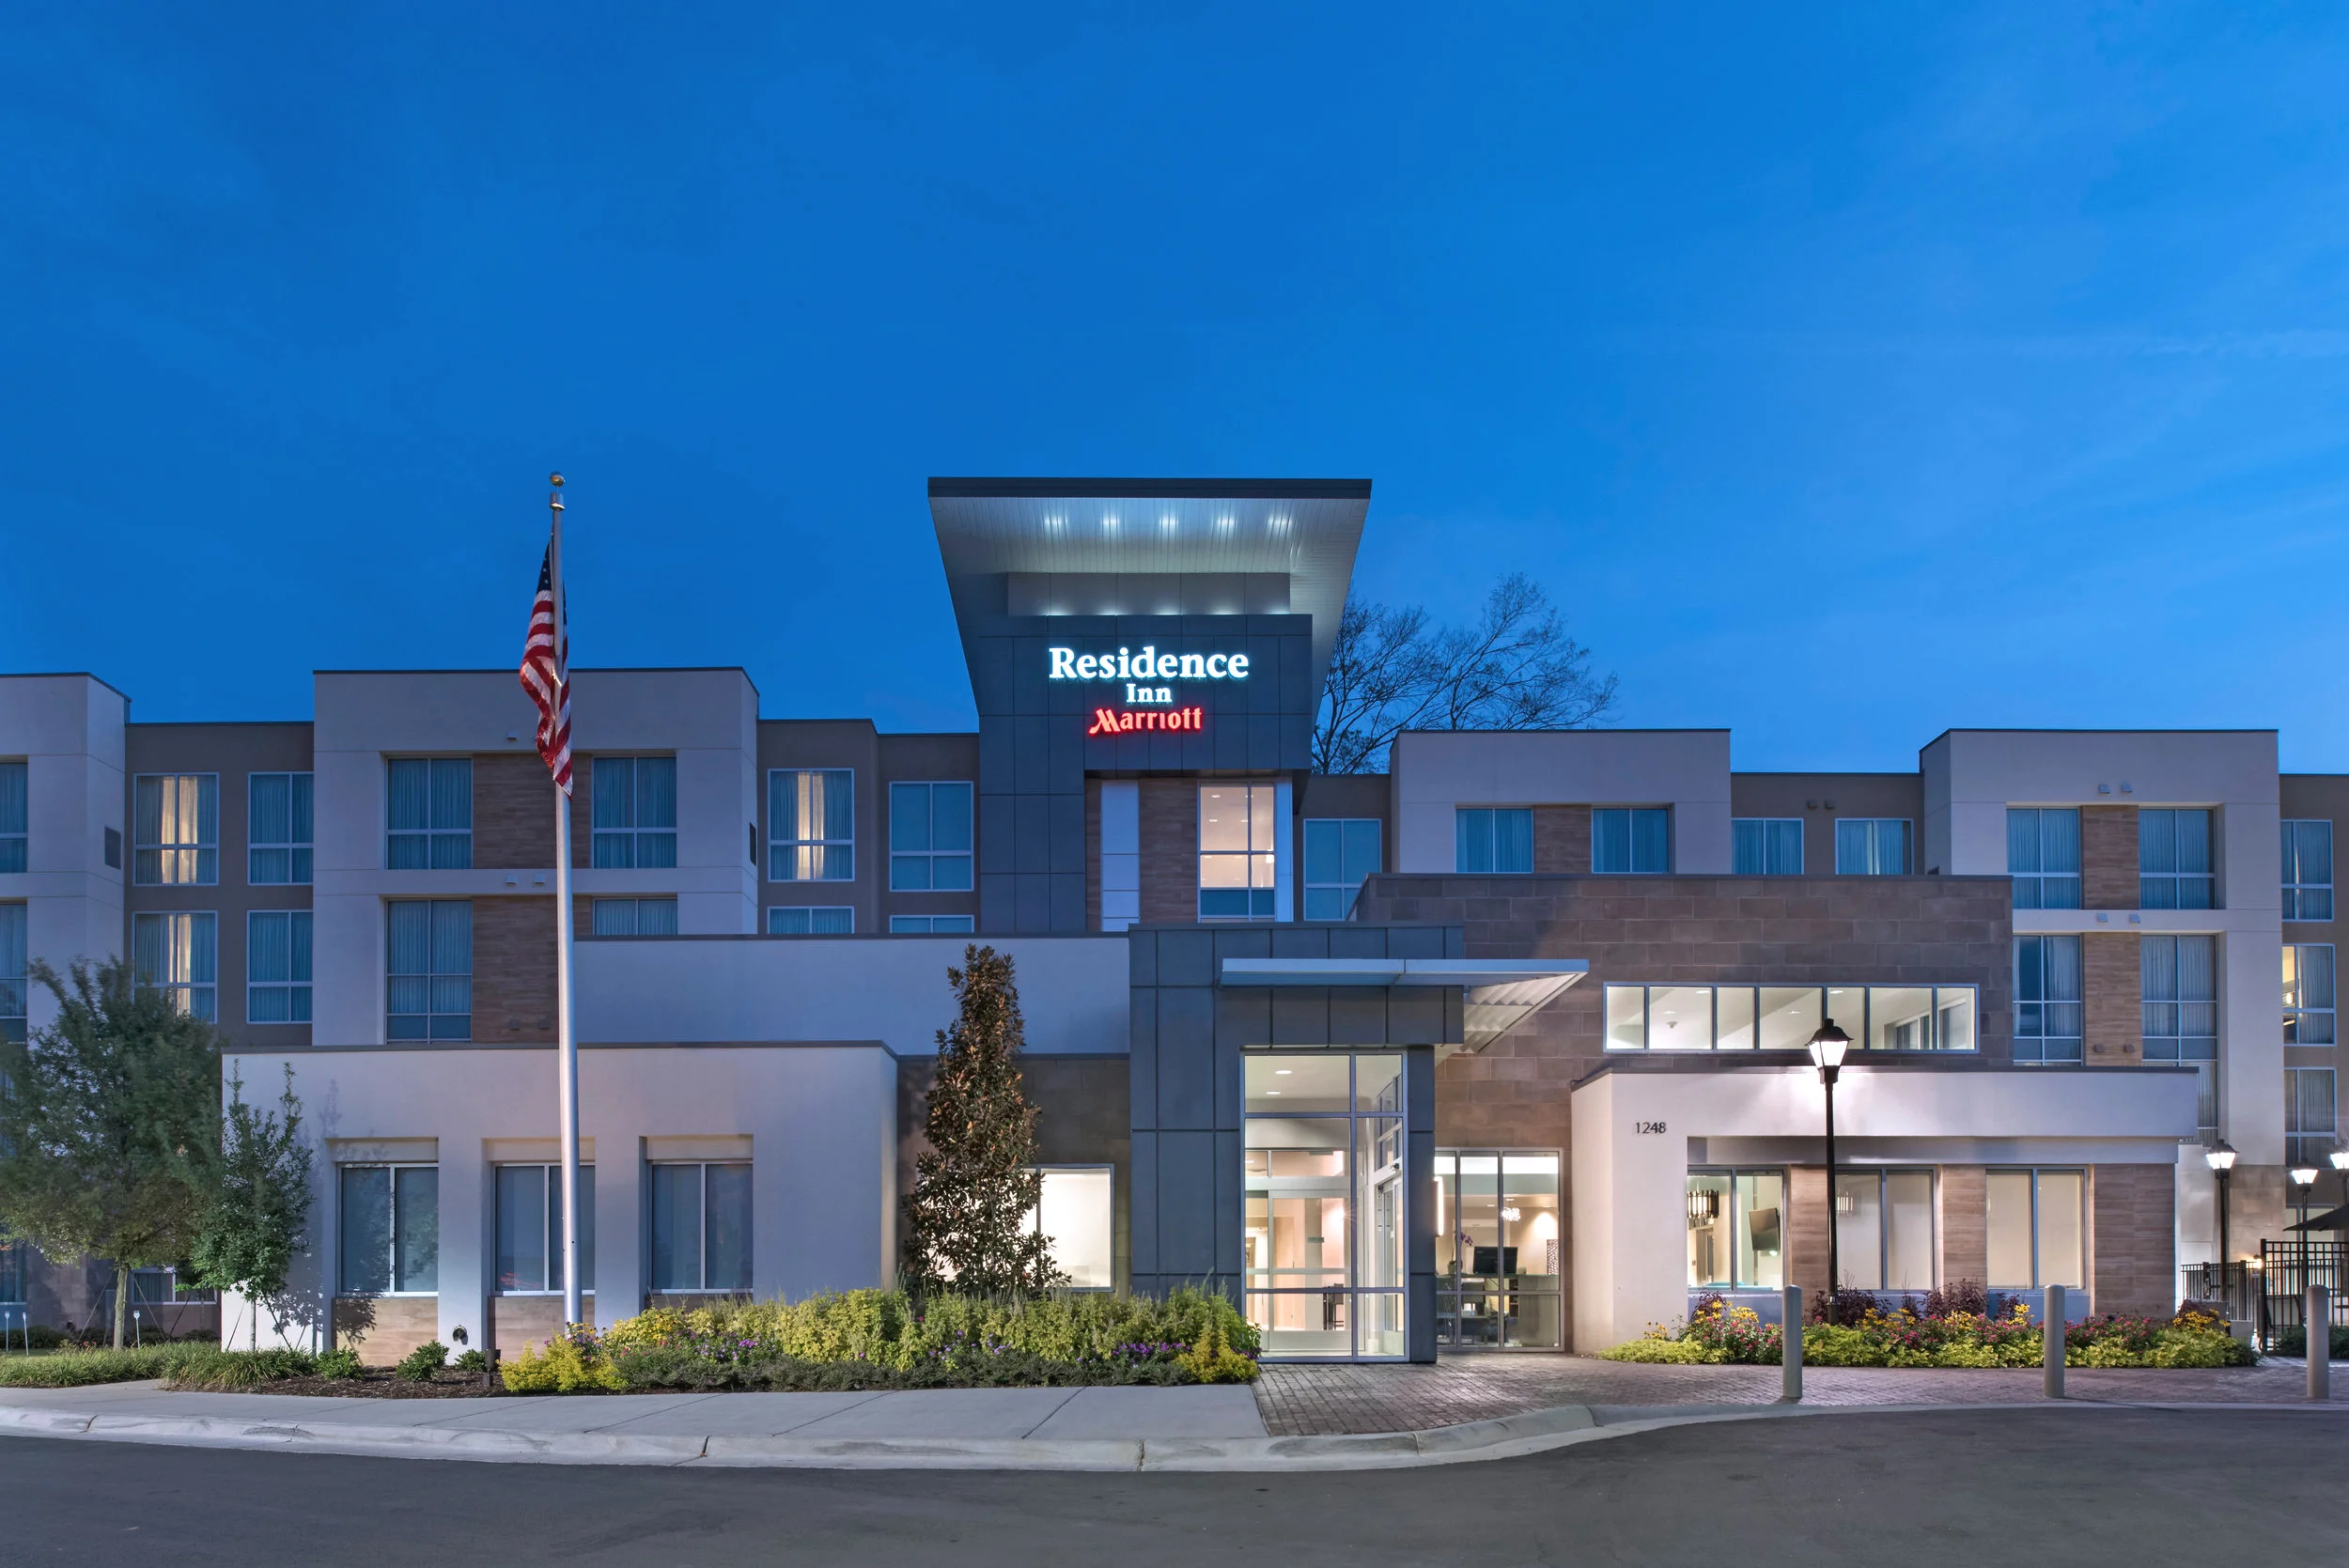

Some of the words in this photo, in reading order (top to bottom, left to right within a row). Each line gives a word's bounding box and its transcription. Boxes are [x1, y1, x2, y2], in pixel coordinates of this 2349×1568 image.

[1049, 646, 1250, 678] Residence
[1126, 683, 1173, 703] Inn
[1089, 707, 1202, 735] Marriott
[1636, 1122, 1666, 1134] 1248
